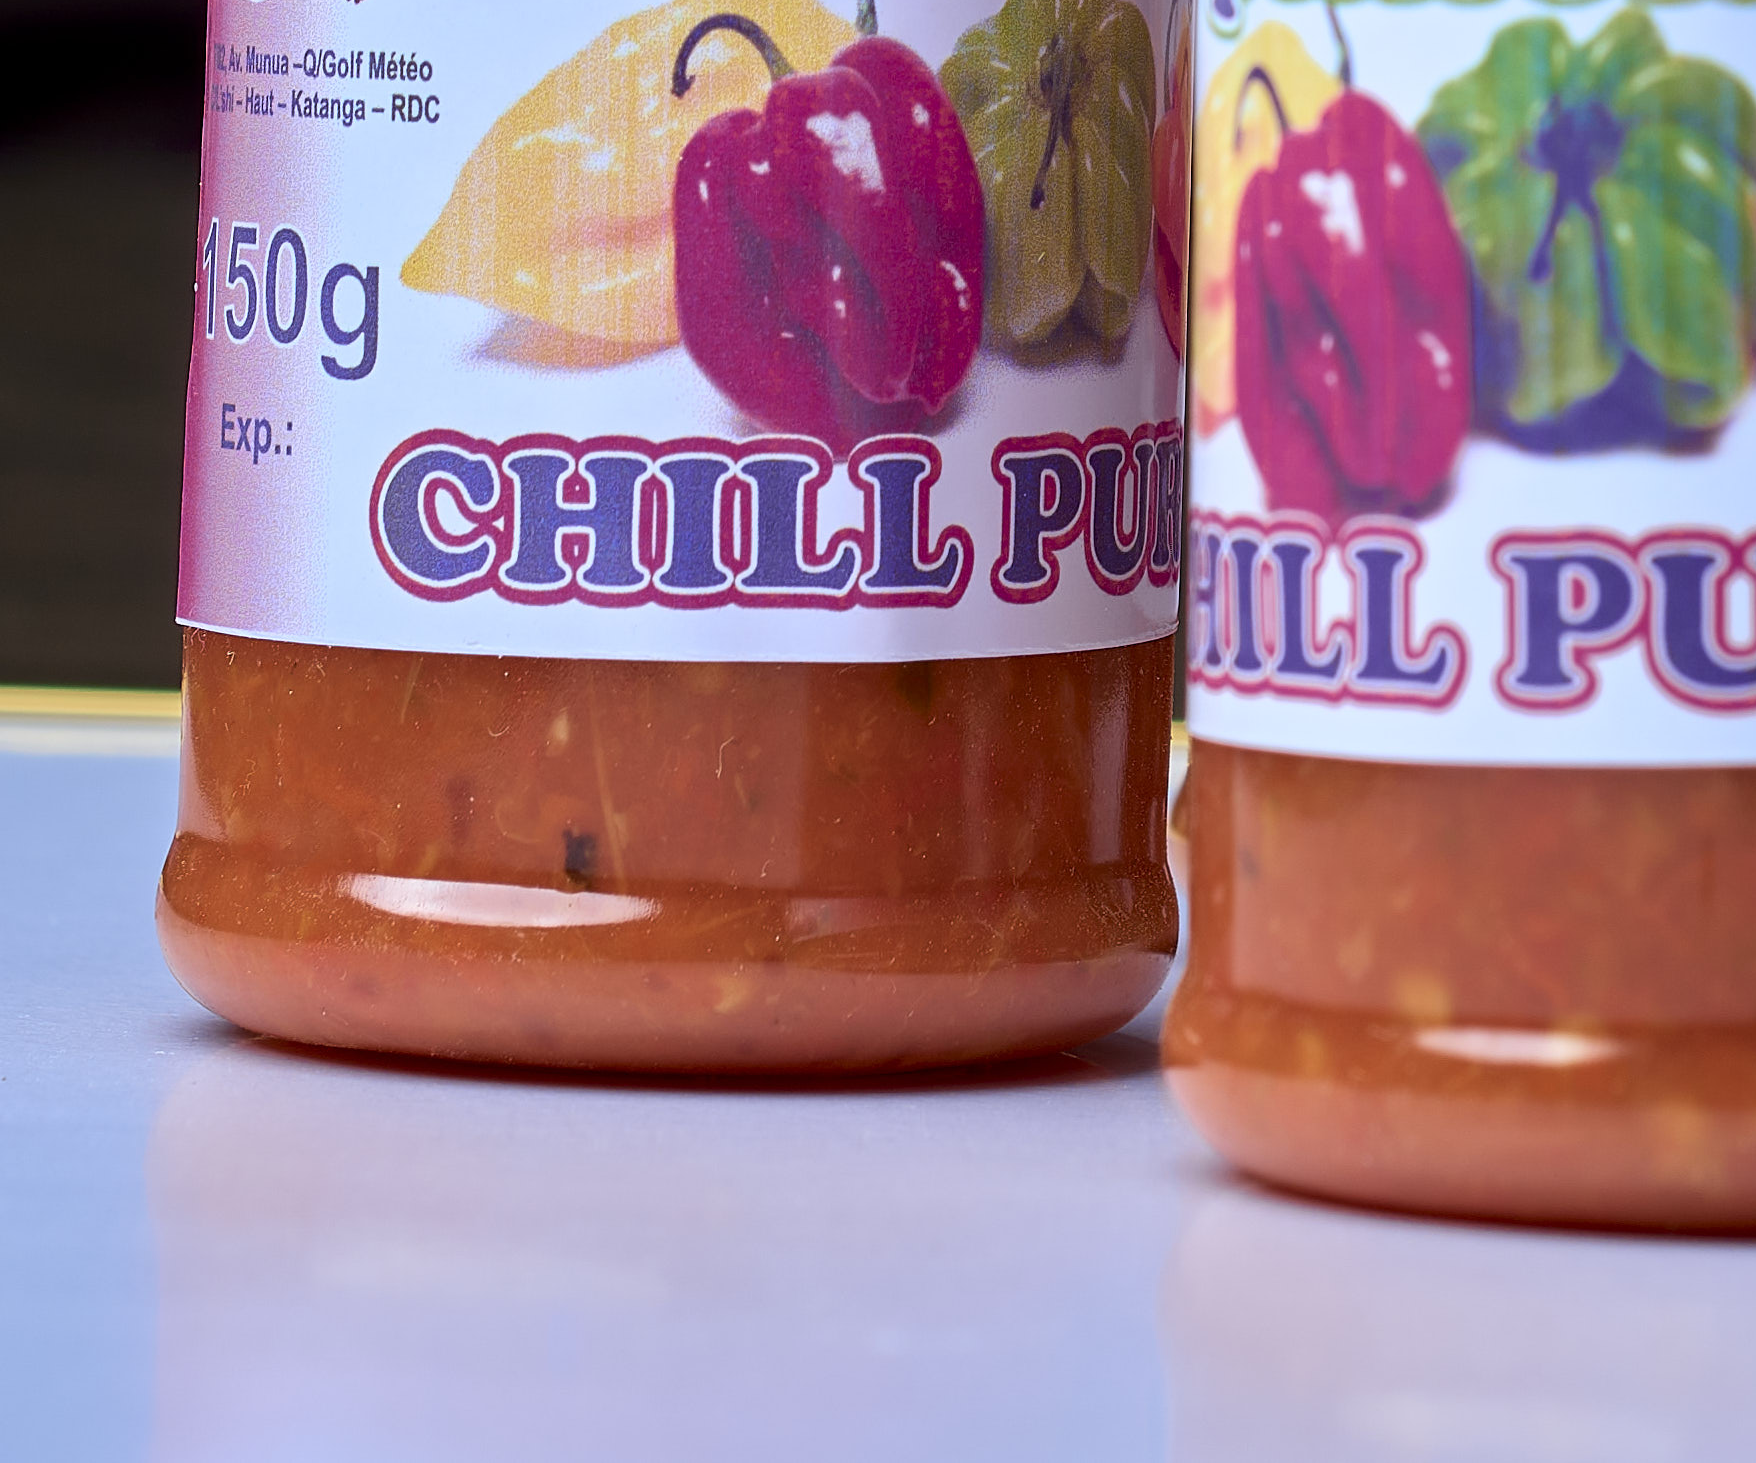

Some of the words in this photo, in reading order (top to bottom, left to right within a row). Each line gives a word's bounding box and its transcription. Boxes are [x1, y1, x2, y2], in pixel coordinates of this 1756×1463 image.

[246, 45, 289, 75] Munua
[369, 51, 434, 82] Météo
[245, 87, 275, 116] Haut
[291, 89, 367, 127] Katanga
[391, 93, 441, 124] RDC
[220, 402, 293, 466] Exp.:
[376, 437, 966, 603] CHILL
